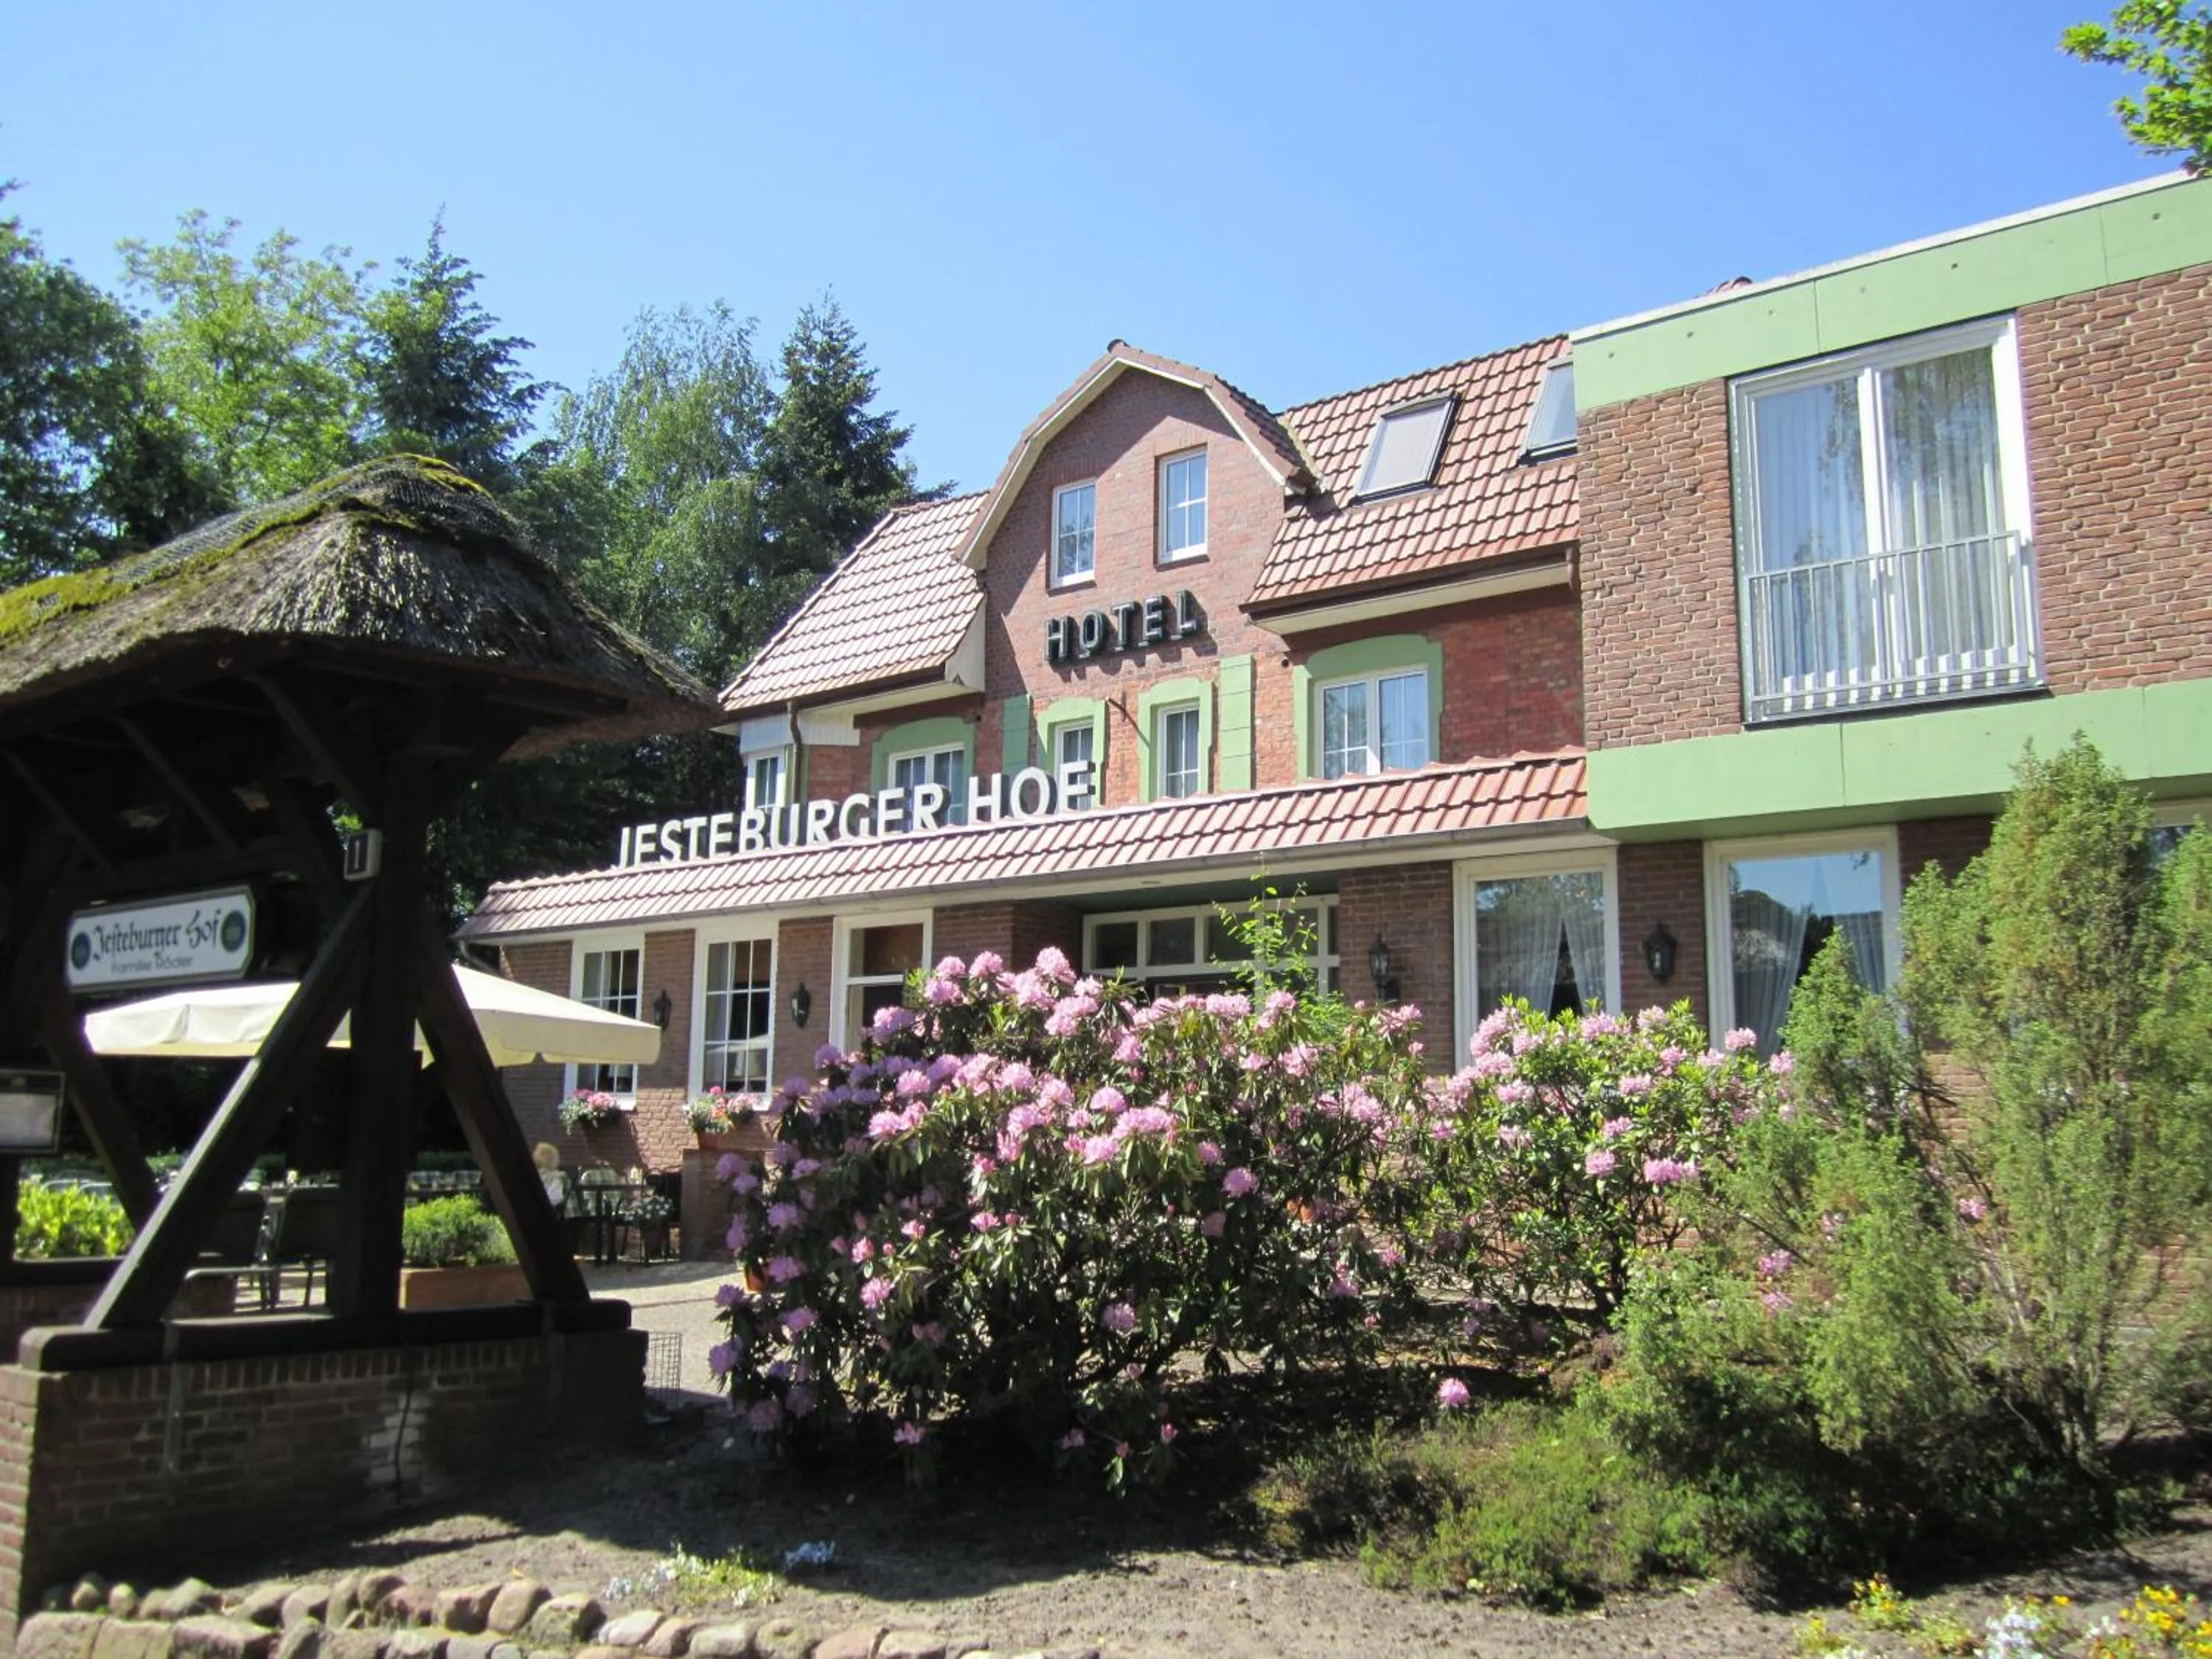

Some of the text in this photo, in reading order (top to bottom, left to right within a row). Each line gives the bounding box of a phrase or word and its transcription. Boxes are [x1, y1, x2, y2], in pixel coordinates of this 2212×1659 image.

[1045, 590, 1199, 661] HOTEL
[611, 759, 1096, 871] JESTEBURGER HOF
[186, 910, 221, 950] Hof
